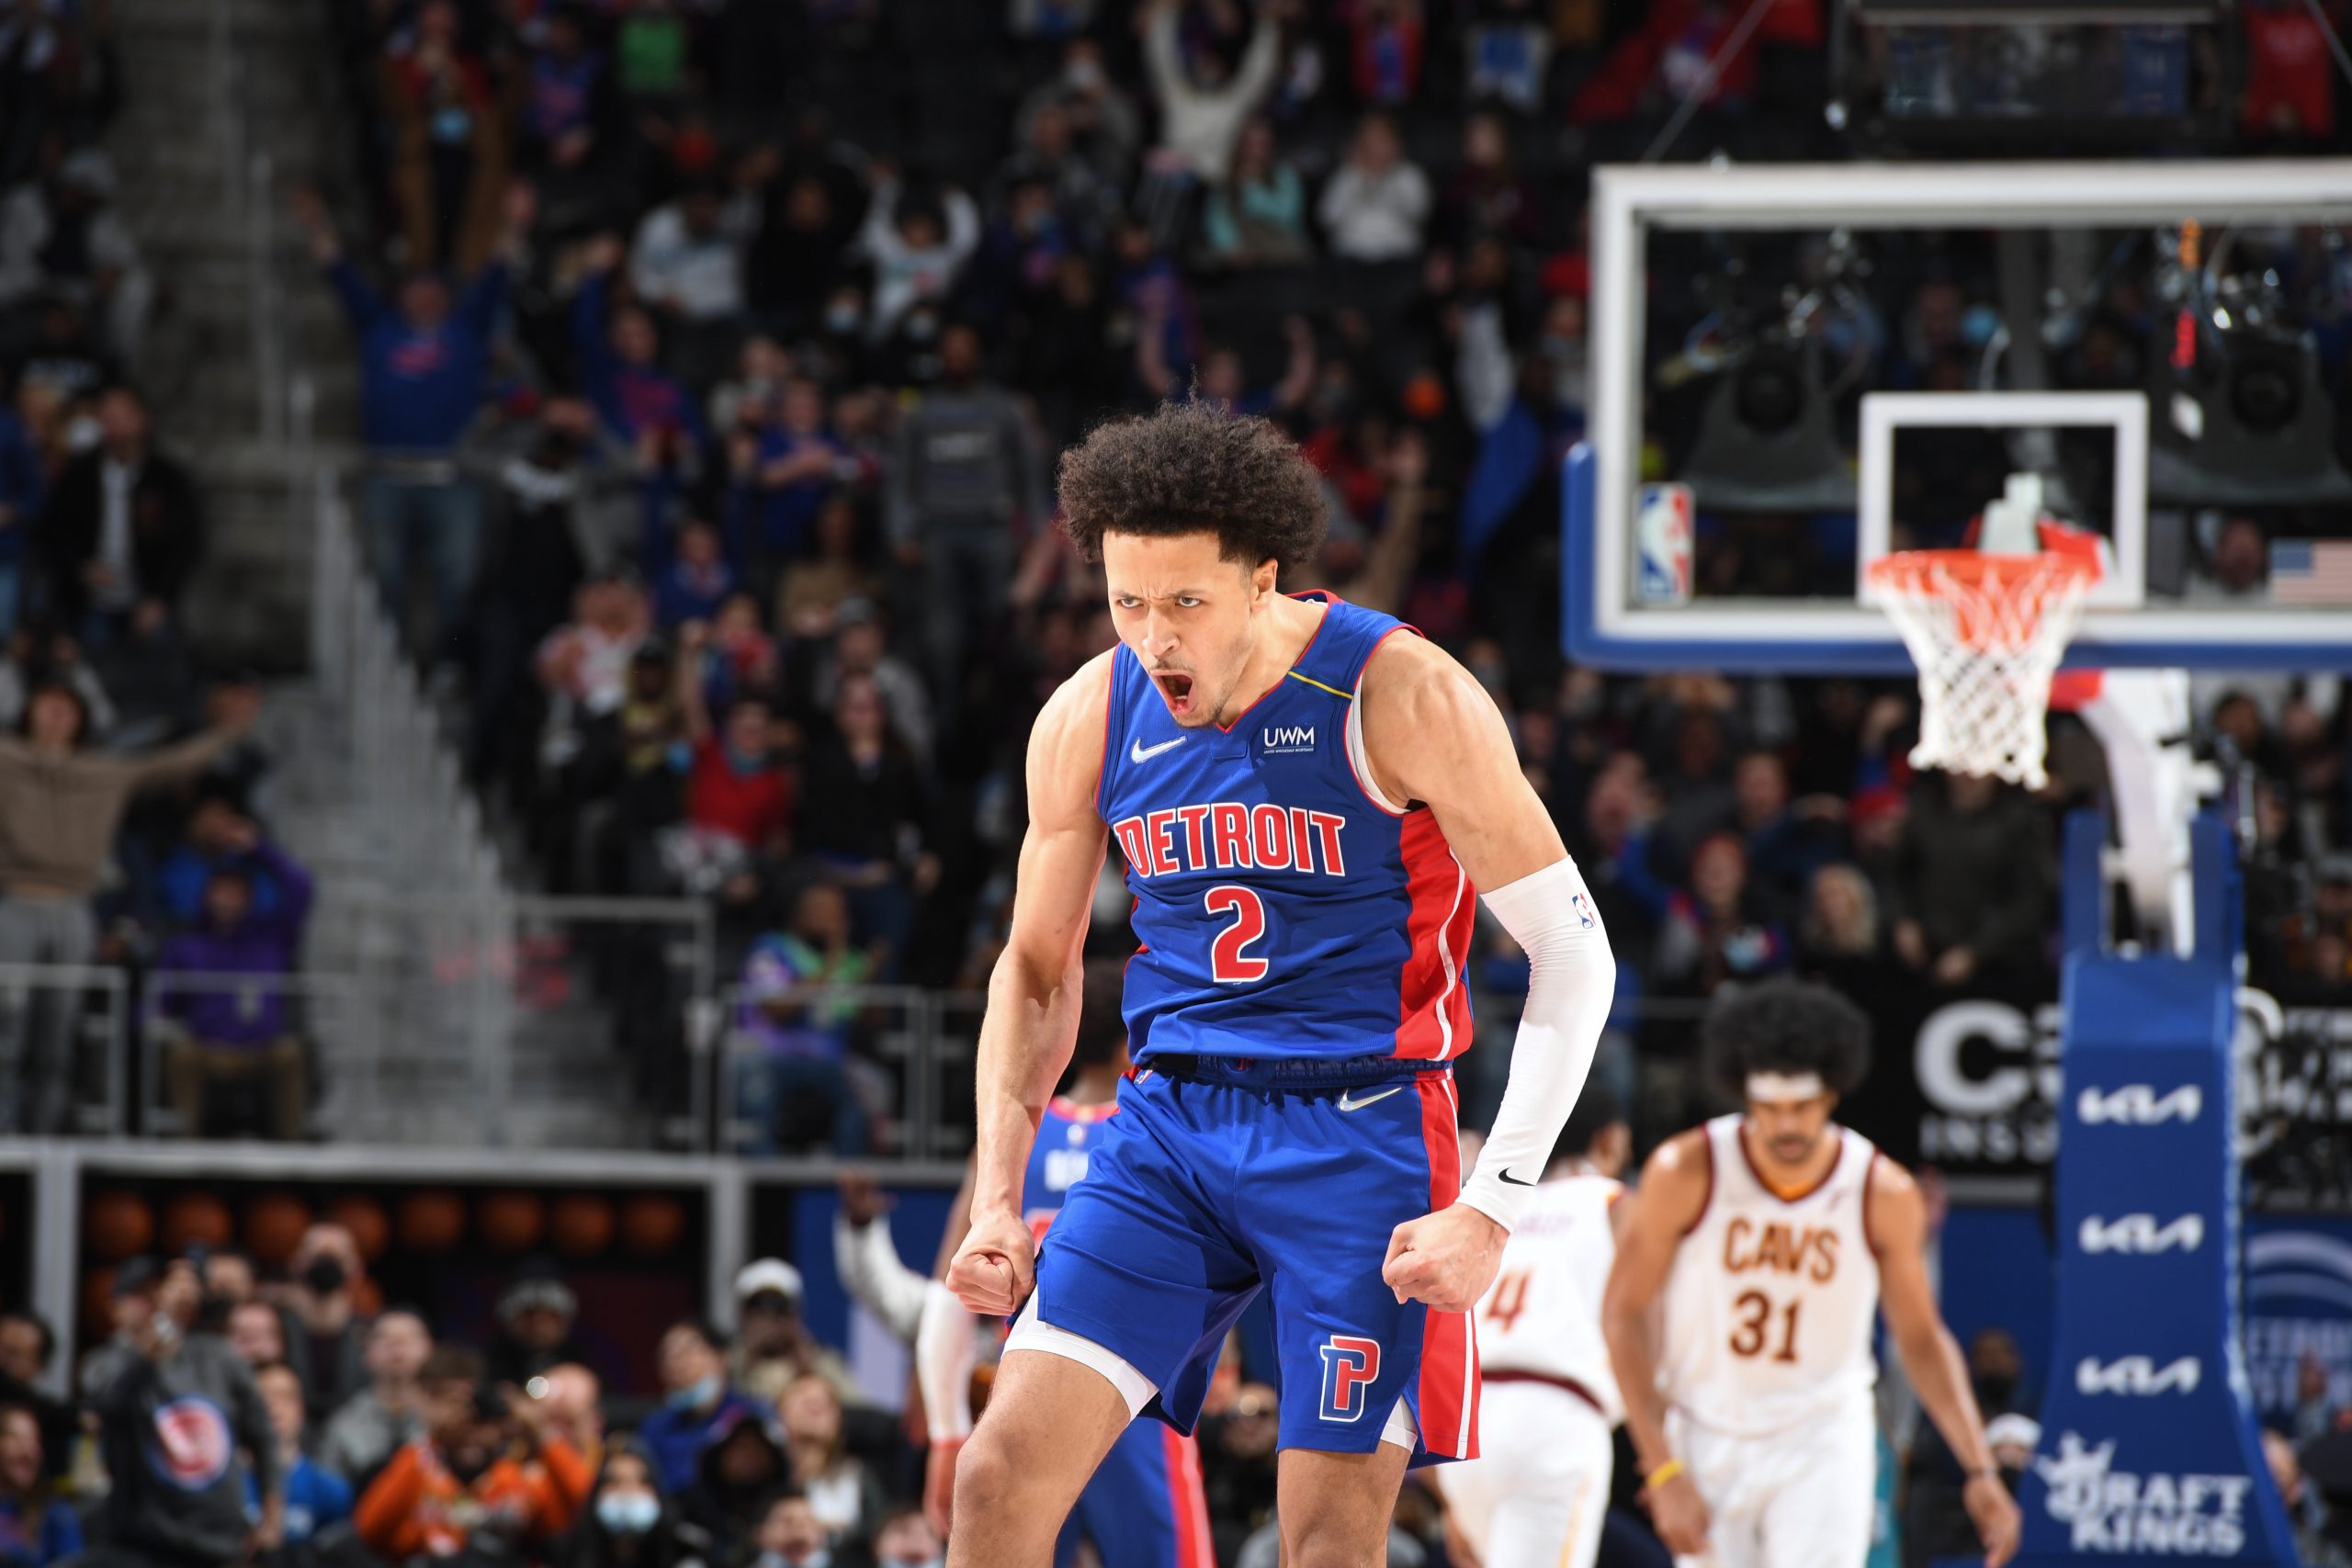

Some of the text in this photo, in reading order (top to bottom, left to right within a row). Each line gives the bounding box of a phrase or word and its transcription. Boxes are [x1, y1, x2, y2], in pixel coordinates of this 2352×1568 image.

[1264, 727, 1314, 747] UWM
[1114, 802, 1346, 878] DETROIT
[1204, 885, 1269, 983] 2
[1724, 1217, 1840, 1284] CAVS
[1485, 1269, 1535, 1334] 4
[1729, 1289, 1803, 1363] 31
[2071, 1512, 2245, 1556] KINGS
